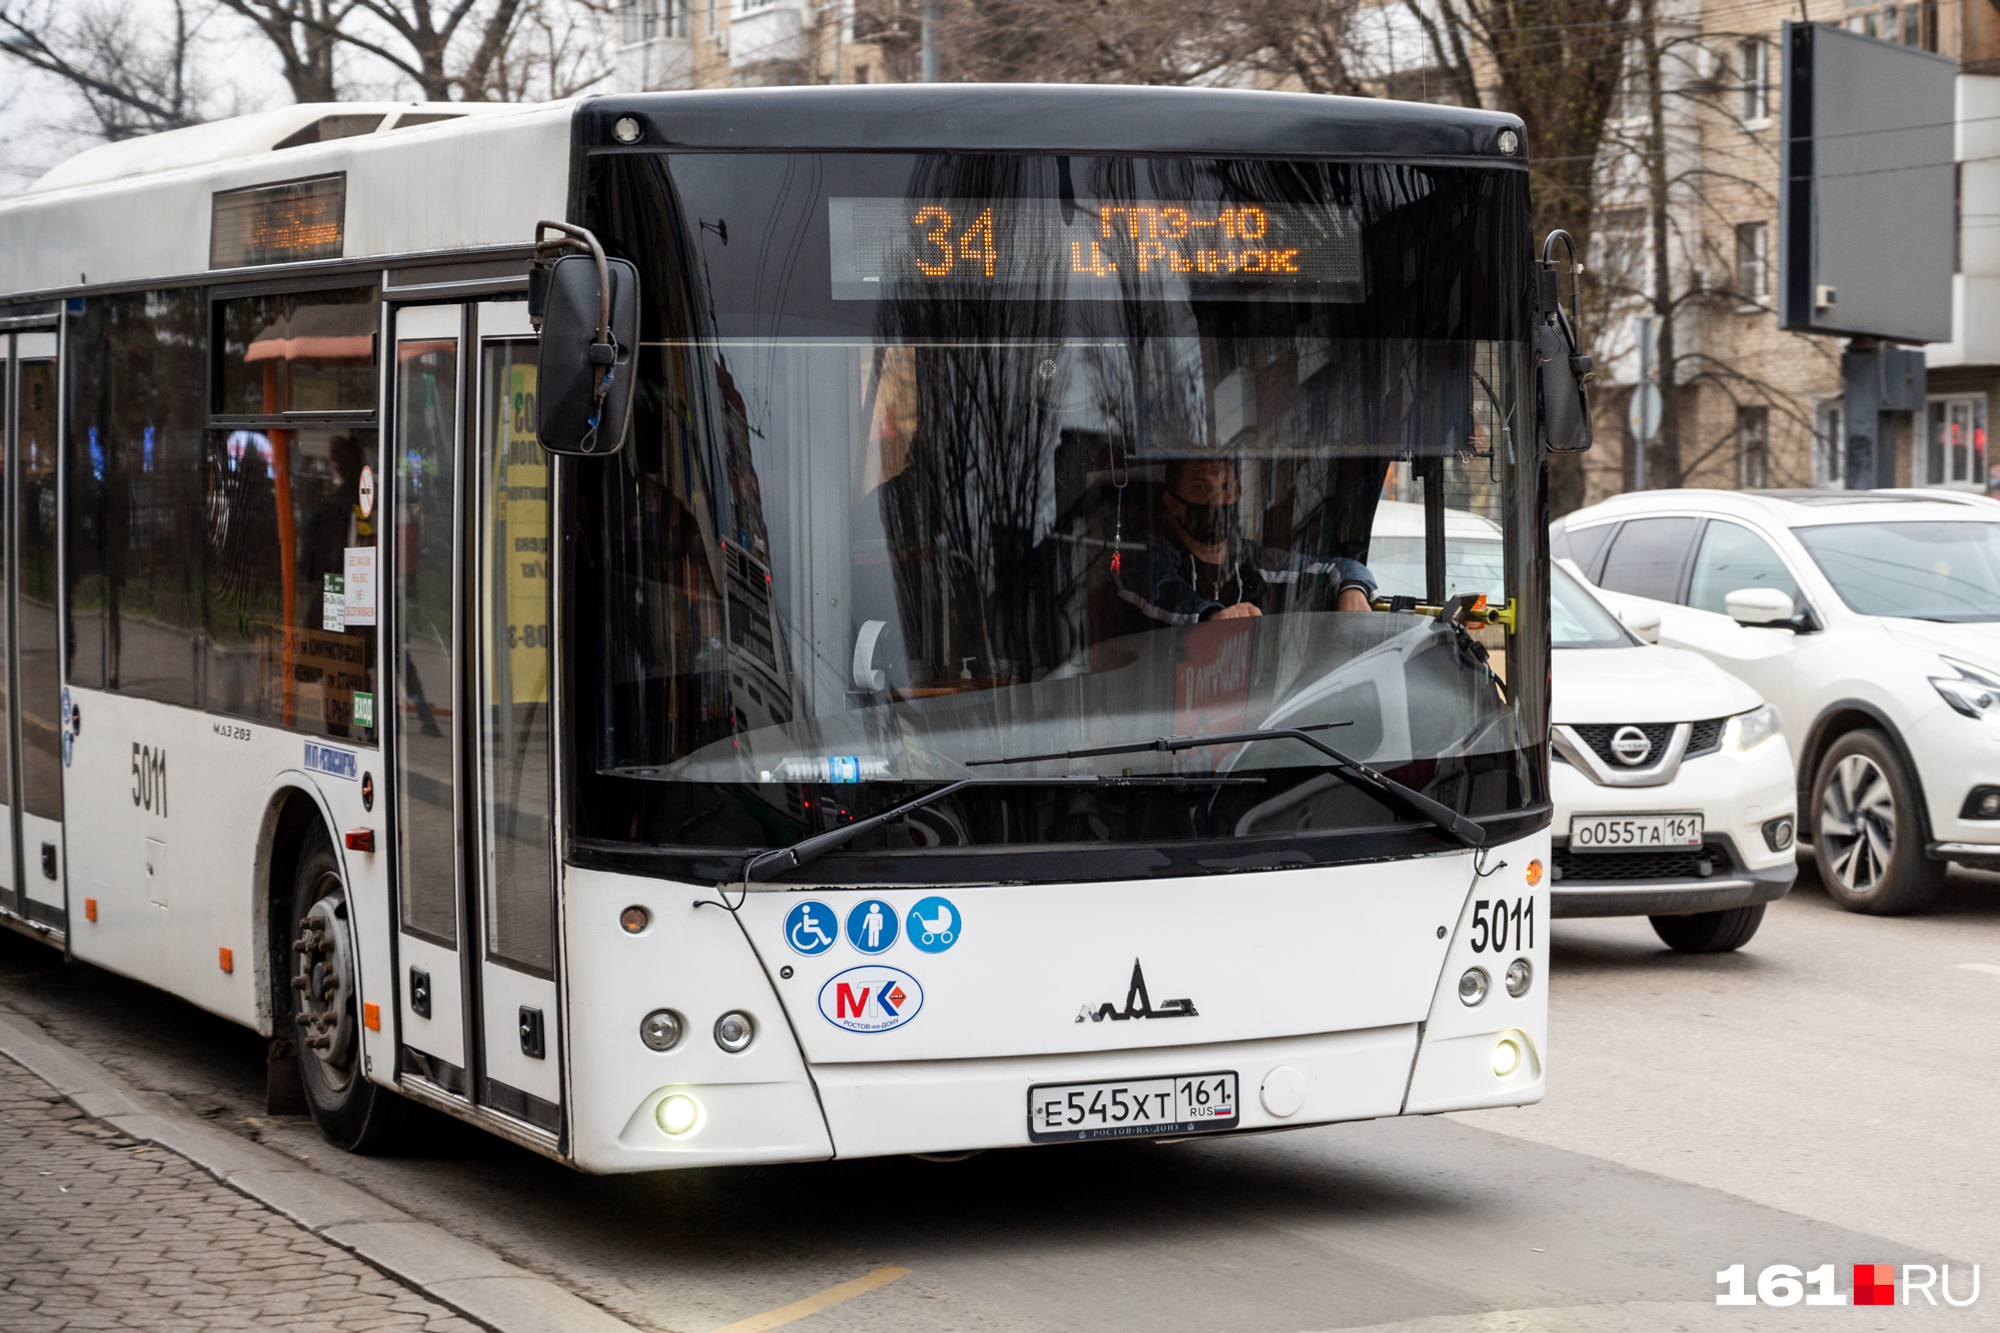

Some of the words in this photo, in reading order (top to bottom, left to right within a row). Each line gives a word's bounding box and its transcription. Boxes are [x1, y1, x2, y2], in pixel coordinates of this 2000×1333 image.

[1099, 207, 1266, 239] ГПЗ-10
[914, 205, 997, 277] 34
[1138, 242, 1299, 274] Рынок
[355, 697, 372, 725] ВХОД
[233, 727, 251, 741] 203
[131, 741, 168, 818] 5011
[1579, 821, 1661, 844] О055ТА
[1667, 819, 1696, 837] 161
[1470, 896, 1535, 954] 5011
[1045, 1088, 1171, 1127] Е545ХТ
[1180, 1078, 1227, 1107] 161
[1189, 1105, 1214, 1117] RUS
